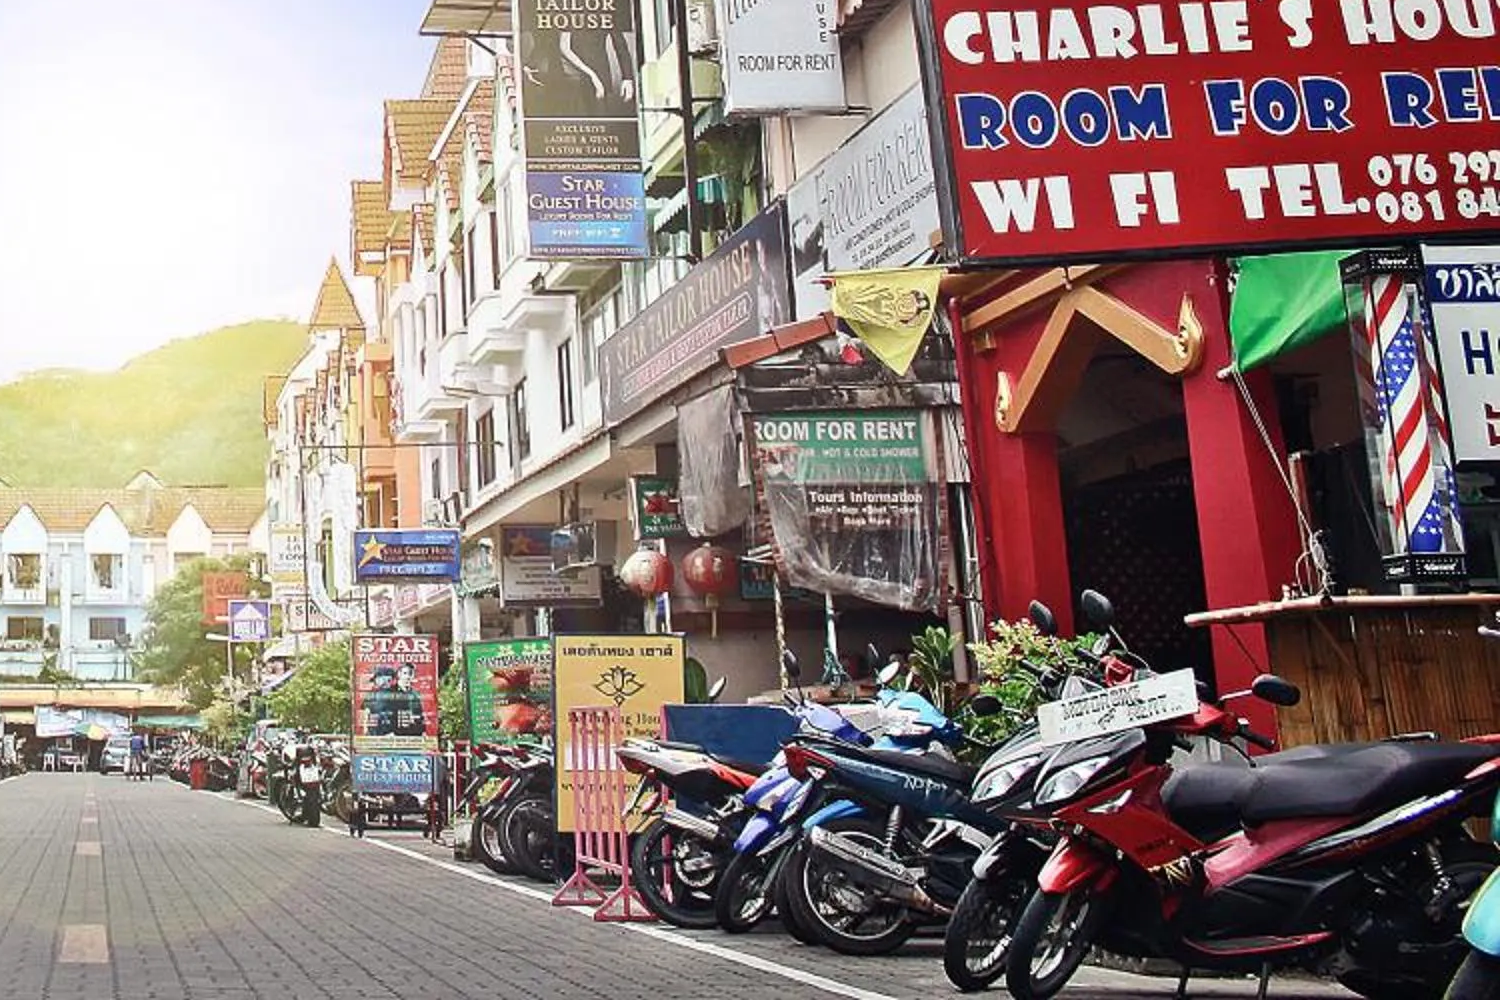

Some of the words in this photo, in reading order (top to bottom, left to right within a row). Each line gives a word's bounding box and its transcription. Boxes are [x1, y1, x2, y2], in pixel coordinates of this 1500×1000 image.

[537, 13, 615, 30] HOUSE
[738, 56, 775, 72] ROOM
[777, 55, 804, 71] FOR
[805, 54, 837, 71] RENT
[954, 83, 1173, 152] ROOM
[1203, 76, 1355, 136] FOR
[587, 146, 619, 154] TAILOR
[971, 175, 1075, 234] WI
[1109, 170, 1181, 228] FI
[1224, 162, 1370, 220] TEL.
[1367, 153, 1438, 187] 076
[1375, 188, 1446, 223] 081
[1461, 330, 1500, 375] H
[752, 421, 809, 441] ROOM
[816, 421, 858, 441] FOR
[863, 421, 917, 440] RENT
[809, 491, 845, 503] Tours
[357, 638, 433, 653] STAR
[357, 653, 395, 663] TAILOR
[397, 654, 433, 663] HOUSE
[360, 757, 431, 773] STAR
